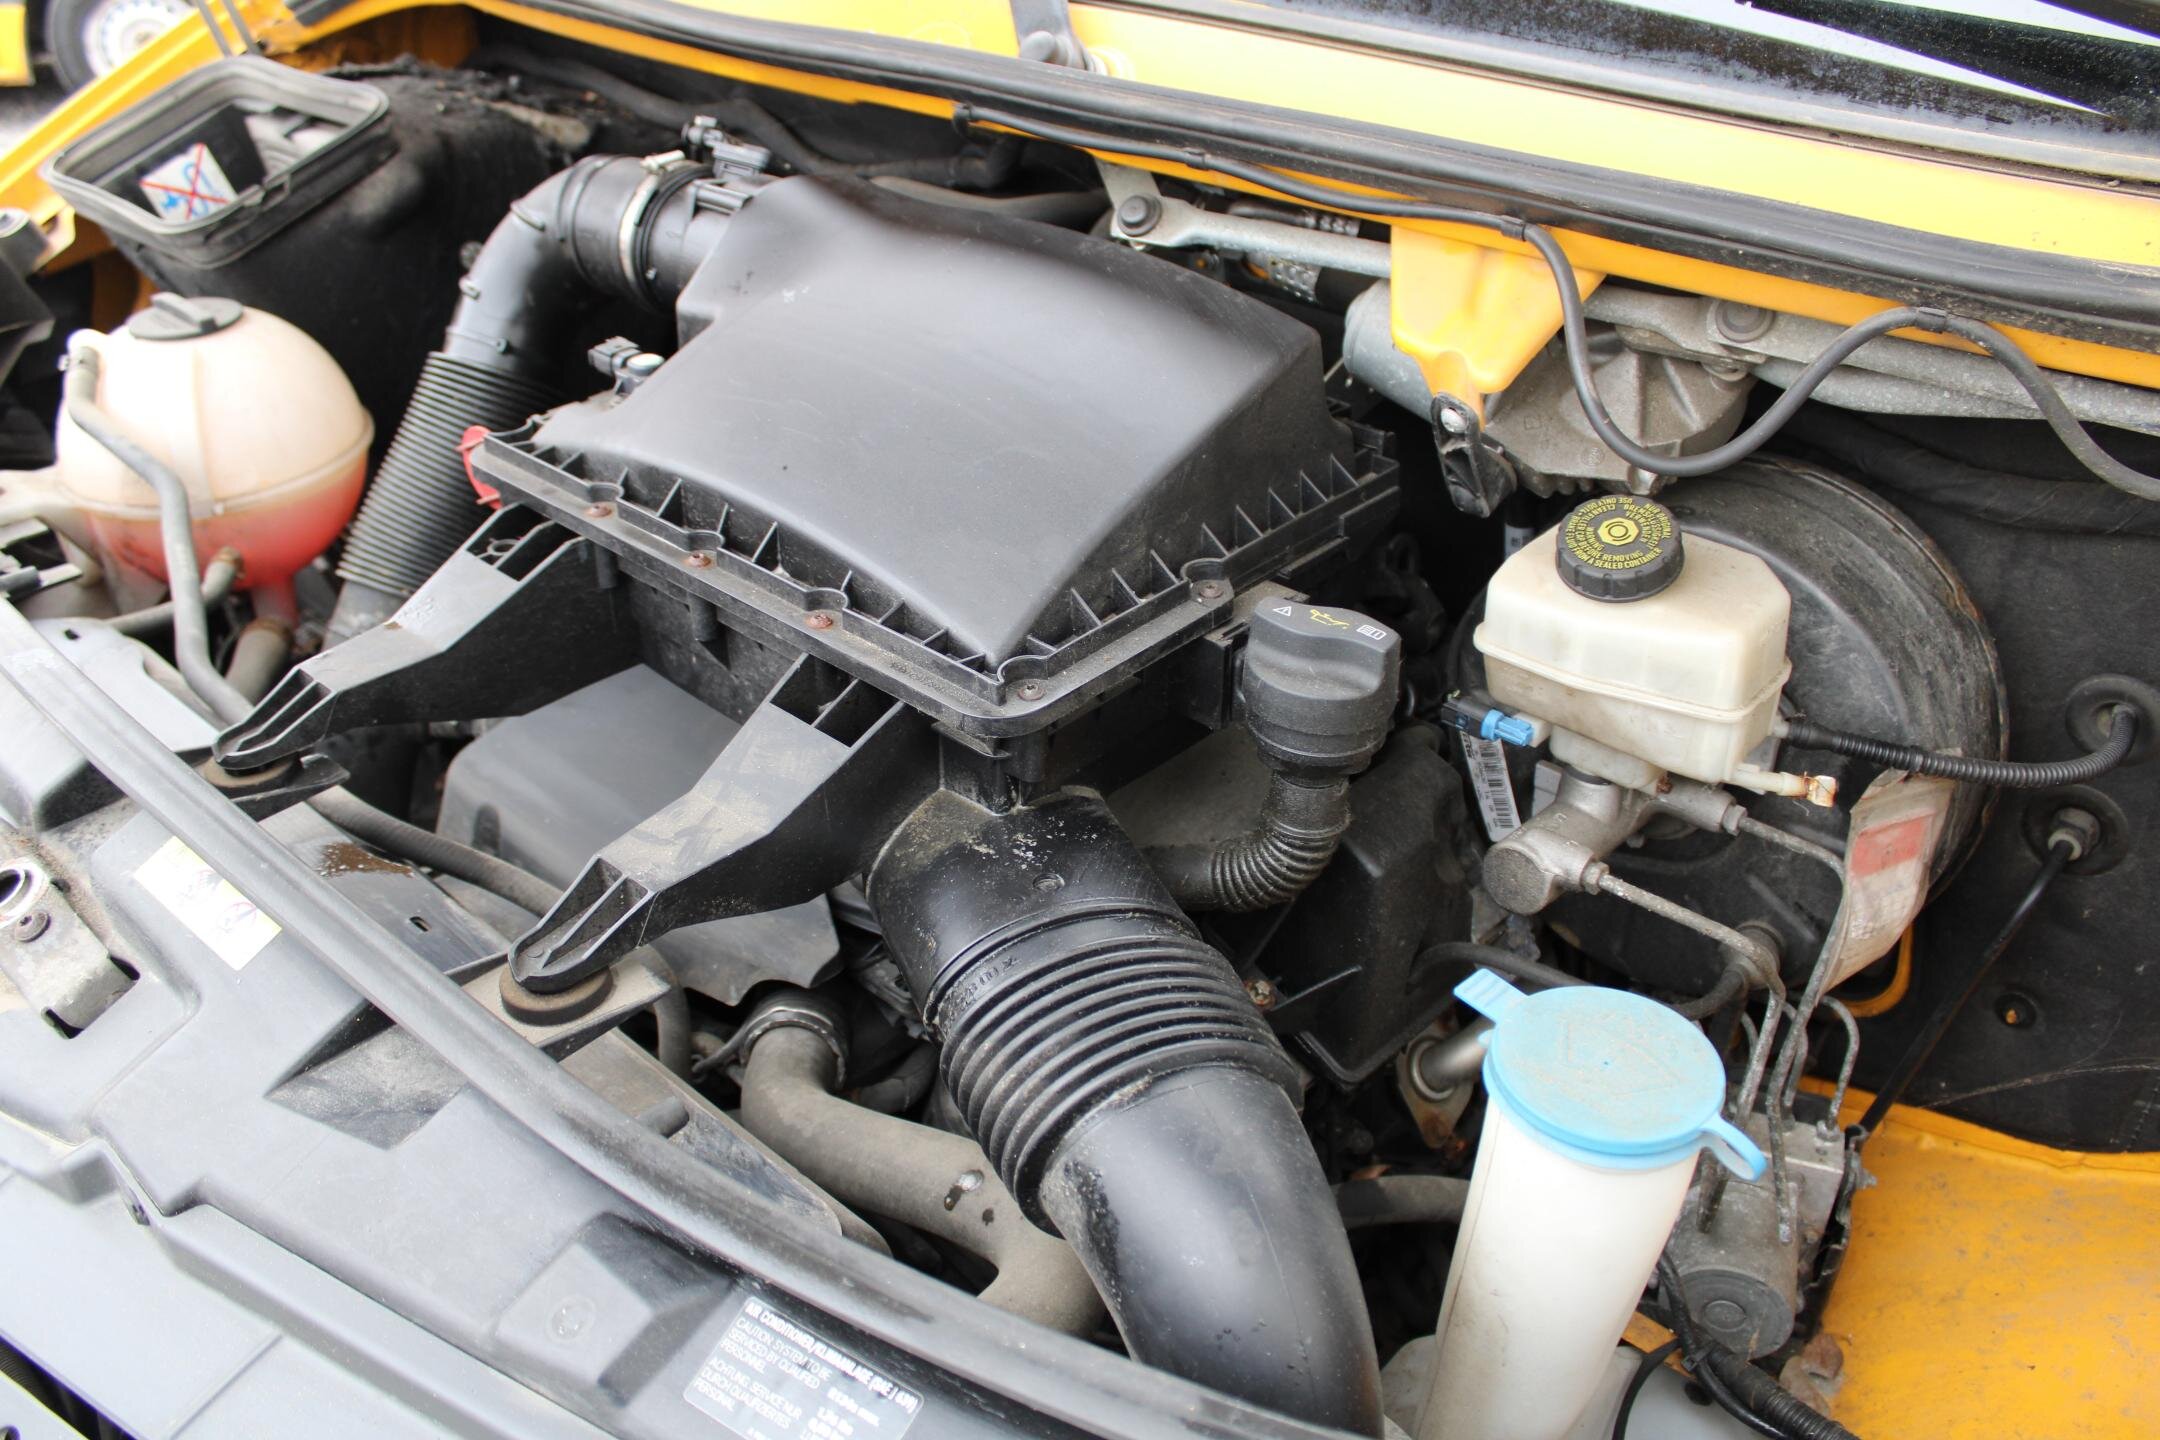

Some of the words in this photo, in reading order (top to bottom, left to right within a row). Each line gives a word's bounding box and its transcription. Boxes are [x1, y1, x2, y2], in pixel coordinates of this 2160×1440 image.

[1591, 503, 1616, 516] CLEAN
[1598, 497, 1617, 507] ONLY
[1578, 540, 1604, 559] BEFORE
[1585, 526, 1606, 551] WARNING
[1594, 559, 1624, 570] SEALED
[1602, 550, 1644, 562] REMOVING
[1624, 547, 1663, 569] CONTAINER
[745, 1302, 762, 1319] AIR
[720, 1337, 765, 1374] PERSONNEL
[728, 1327, 769, 1357] SERVICED
[766, 1350, 779, 1364] BY
[777, 1356, 820, 1389] QUALIFIED
[771, 1339, 809, 1368] SYSTEM
[806, 1358, 820, 1373] TO
[819, 1365, 832, 1381] BE
[701, 1366, 732, 1393] DURCH
[693, 1377, 735, 1412] PERSONAL
[750, 1381, 787, 1410] SERVICE
[784, 1400, 802, 1420] NUR
